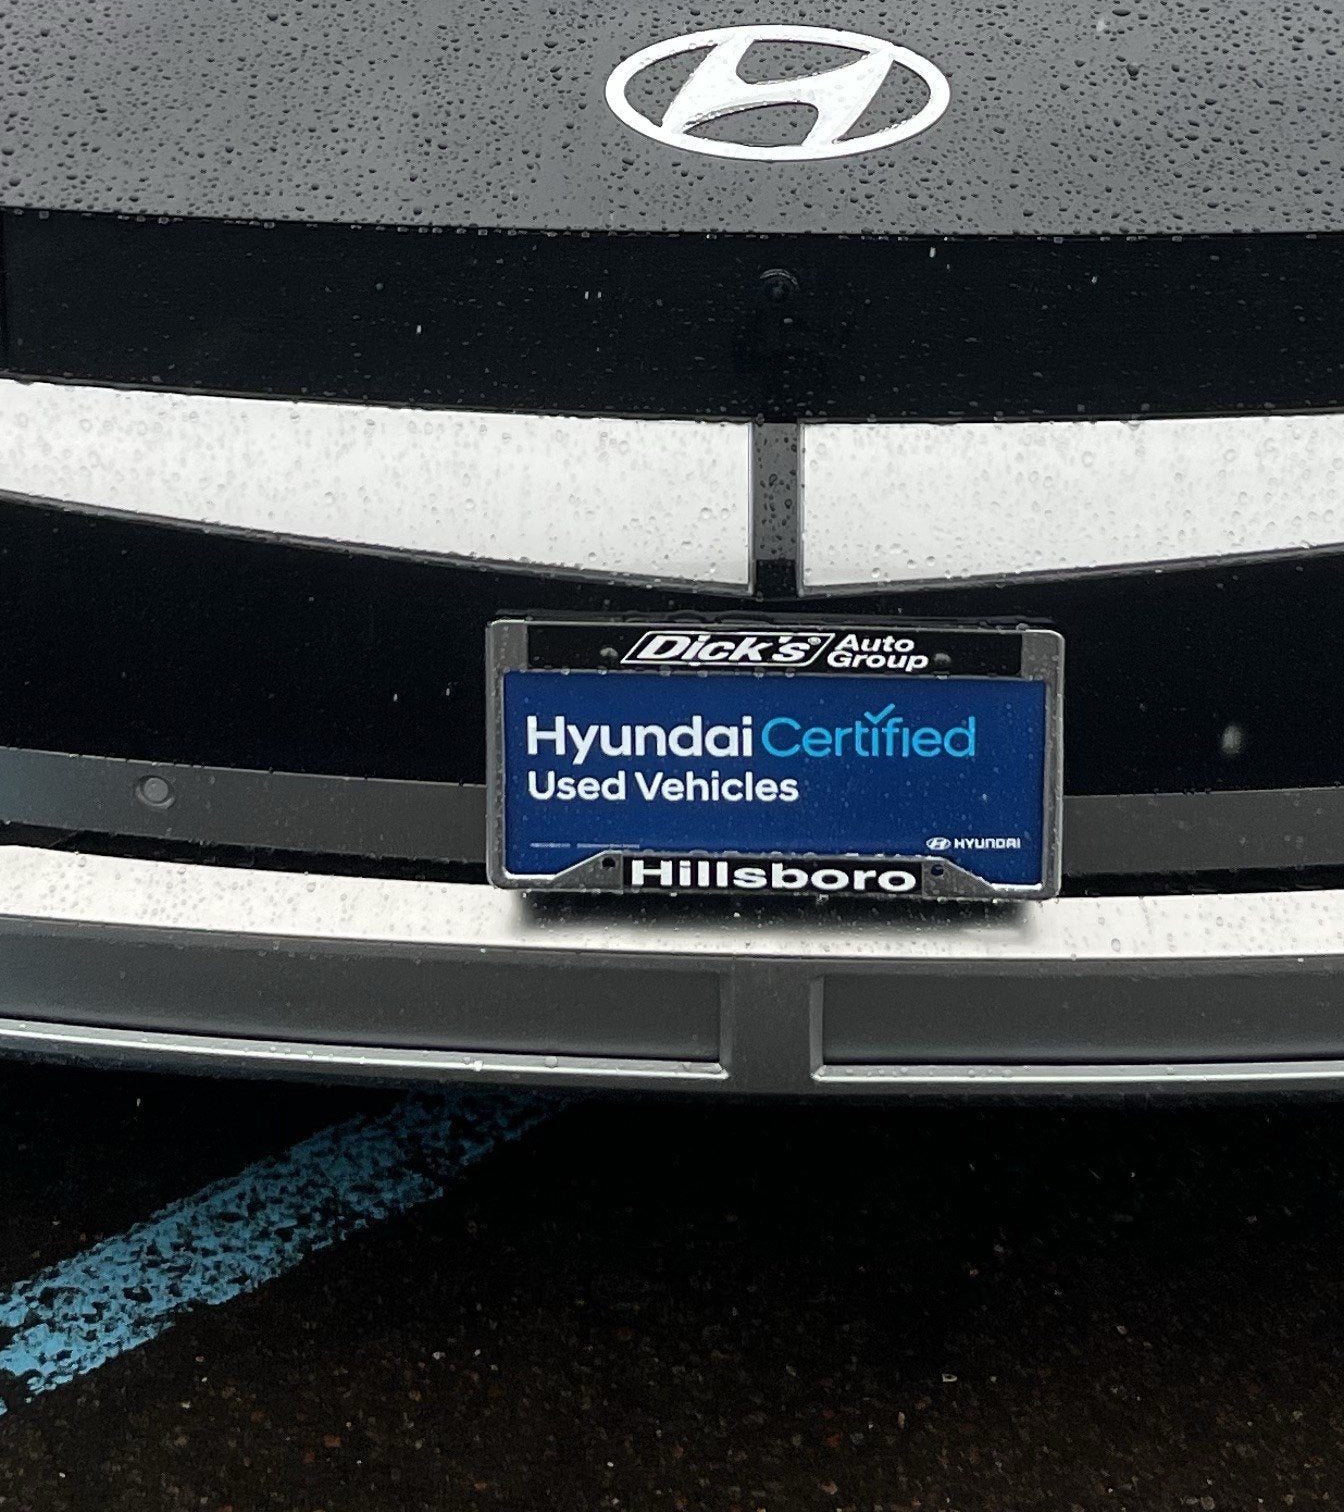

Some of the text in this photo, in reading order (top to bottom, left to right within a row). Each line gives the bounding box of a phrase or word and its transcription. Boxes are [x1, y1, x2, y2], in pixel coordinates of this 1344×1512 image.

[637, 633, 915, 662] Dick's Auto
[827, 650, 929, 672] Group
[526, 703, 976, 765] Hyundai Certified
[528, 770, 799, 802] Used Vehicles
[954, 837, 1021, 849] HYUNDAI
[630, 859, 916, 891] Hillsboro
